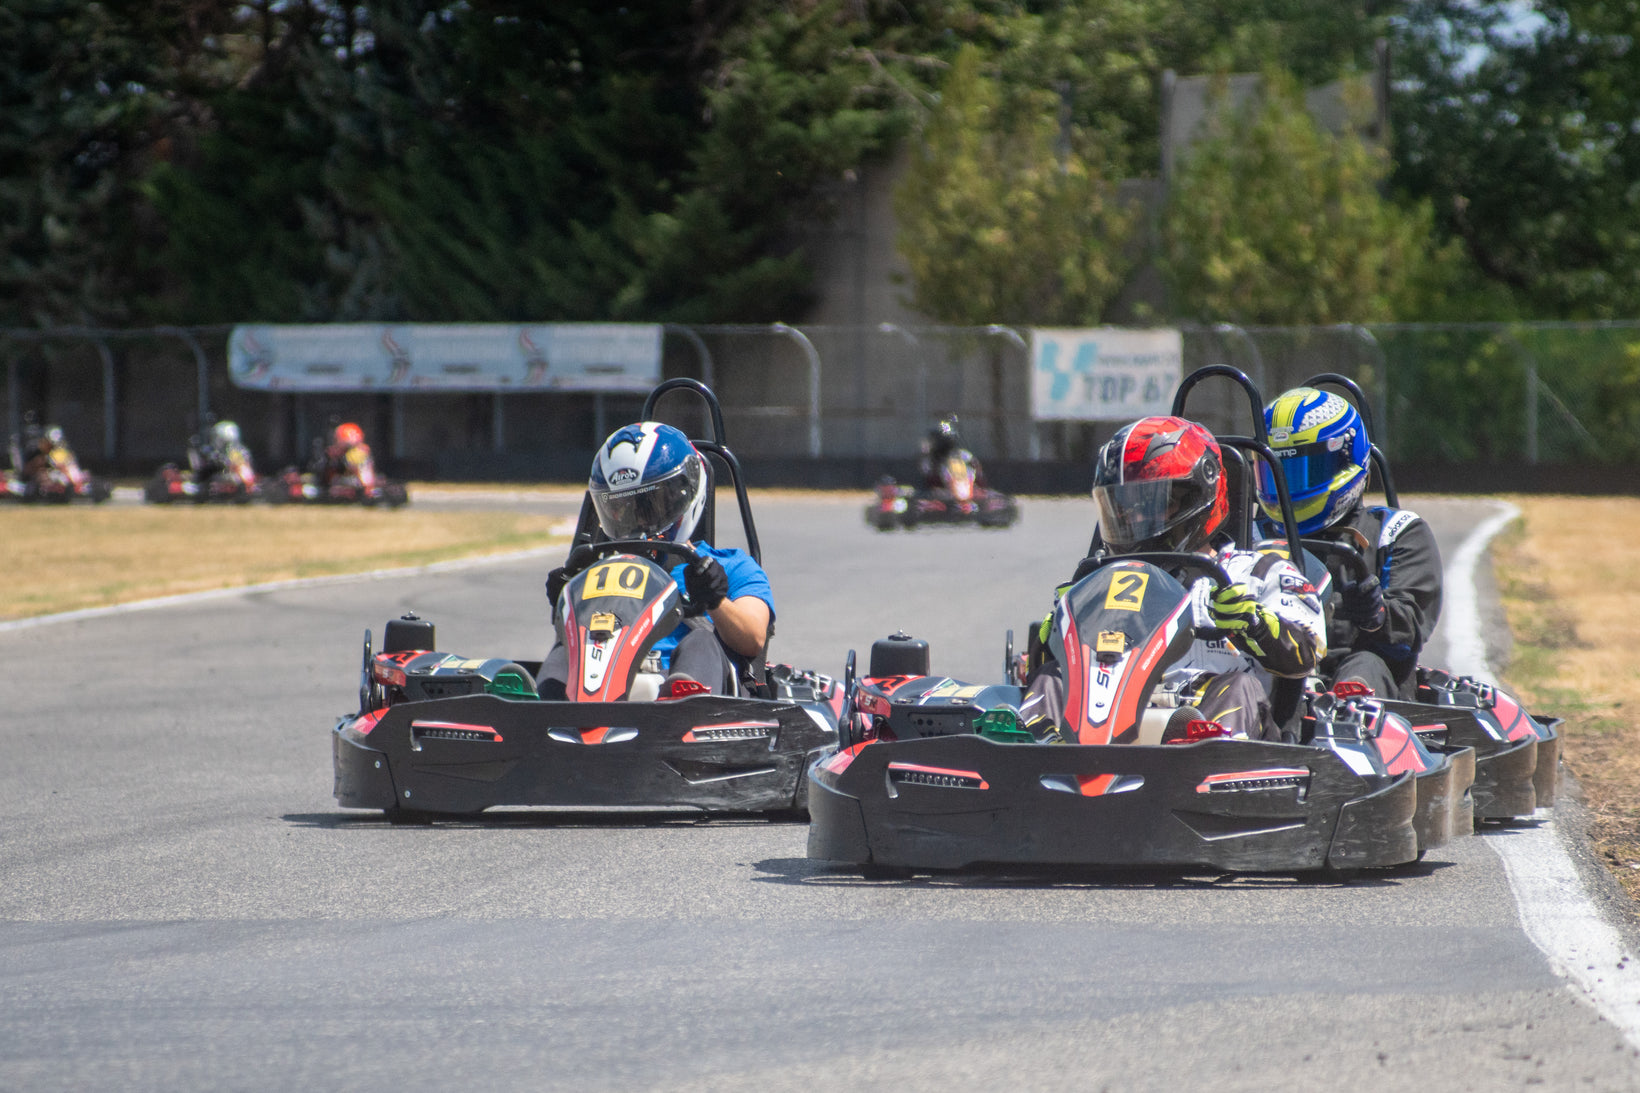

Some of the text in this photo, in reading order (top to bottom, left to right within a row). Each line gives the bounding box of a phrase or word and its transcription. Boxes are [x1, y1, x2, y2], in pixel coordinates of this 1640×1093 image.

[1082, 375, 1136, 402] TOP
[611, 468, 637, 482] Airoh
[595, 565, 645, 592] 10
[1113, 574, 1143, 604] 2
